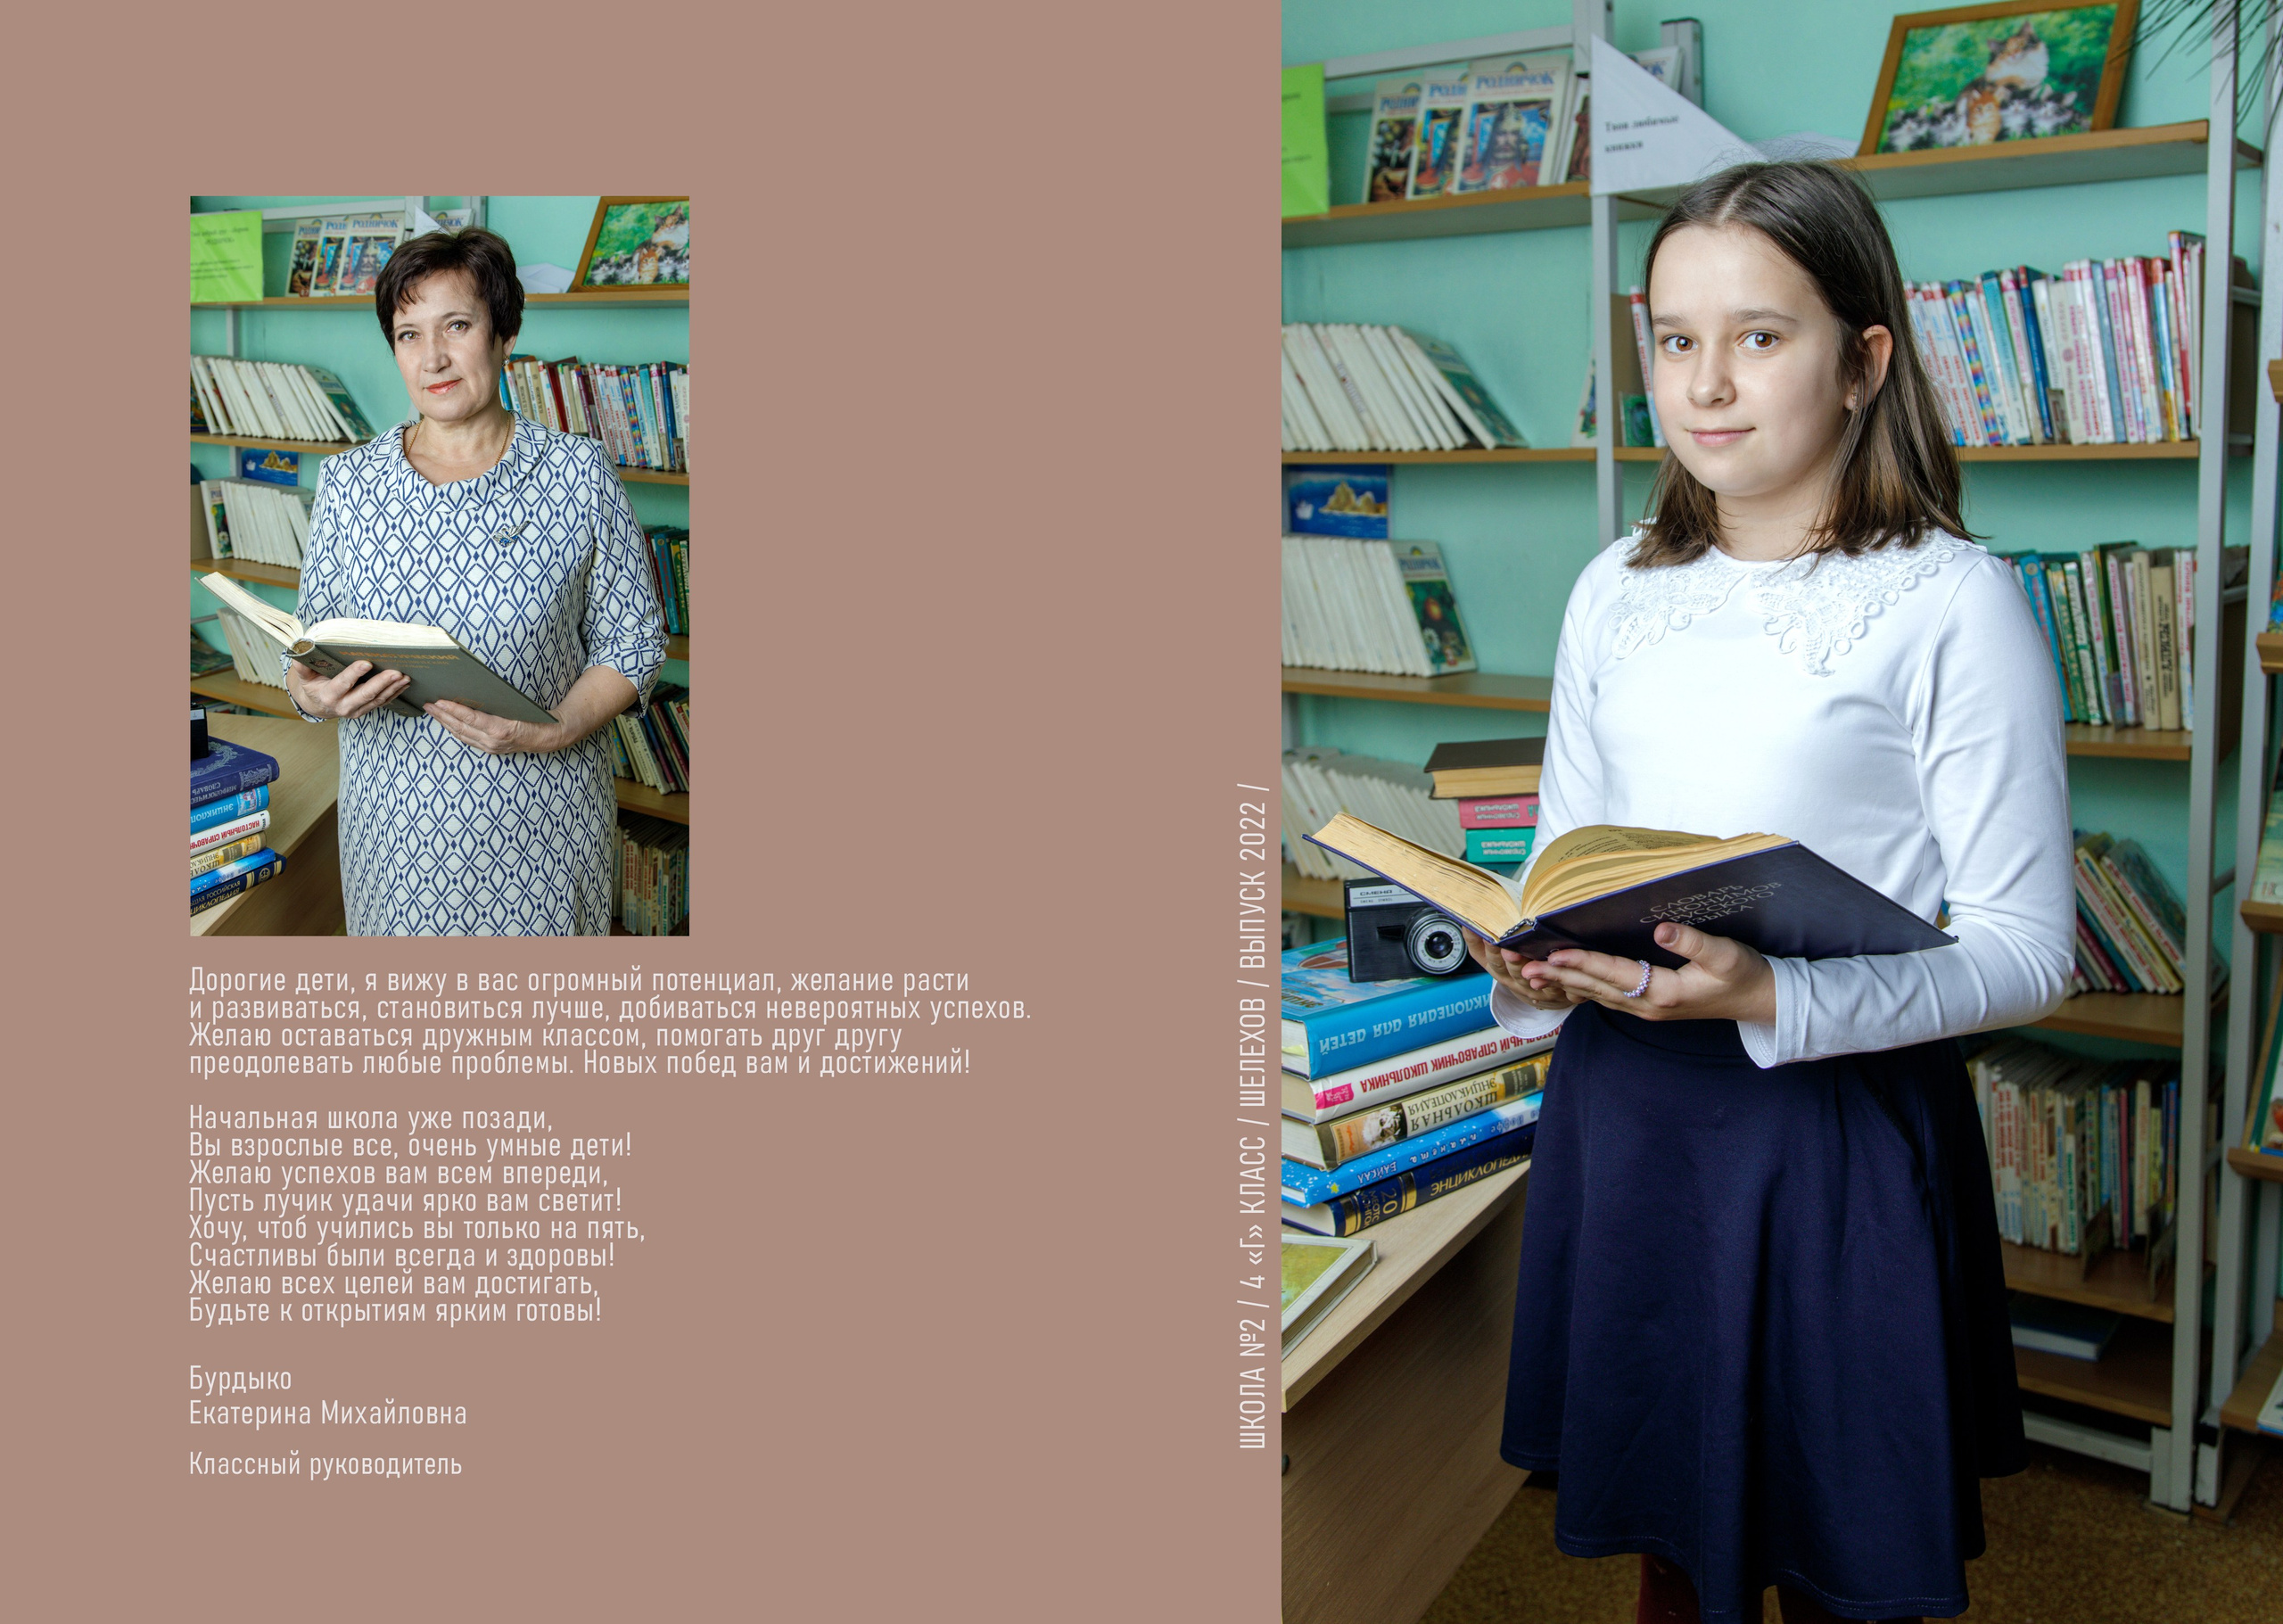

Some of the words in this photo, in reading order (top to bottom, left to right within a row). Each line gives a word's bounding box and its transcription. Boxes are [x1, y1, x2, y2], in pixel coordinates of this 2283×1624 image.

[190, 785, 237, 805] МИФОЛОГИЧЕС
[190, 803, 234, 824] ЭНЦИКЛОП
[190, 832, 220, 850] СПРАВОЧН
[221, 820, 260, 841] НАСТОЛЬНЫЙ
[190, 852, 219, 869] ЭНЦИКЛО
[190, 860, 220, 879] ШКОЛЬ
[190, 887, 241, 915] ЦИКЛОПЕДИЯ
[206, 880, 241, 900] РОССИЙСКАЯ
[1639, 881, 1782, 924] СИНОНИМОВ
[1650, 885, 1743, 912] СЛОВАРЬ
[1669, 892, 1774, 923] РУССКОГО
[1407, 993, 1491, 1027] ИКЛОПЕДИЯ
[1372, 1018, 1402, 1039] ДЛЯ
[1319, 1031, 1366, 1056] ДЕТЕЙ
[1431, 1042, 1497, 1073] СПРАВОЧНИК
[1360, 1061, 1429, 1093] ШКОЛЬНИКА
[1407, 1077, 1497, 1116] ЭНЦИКЛОПЕДИЯ
[1410, 1091, 1498, 1133] ШКОЛЬНАЯ
[1356, 1161, 1397, 1184] БАЙКАЛ
[1430, 1154, 1529, 1197] ЭНЦИКЛОПЕД
[1381, 1188, 1397, 1215] 20
